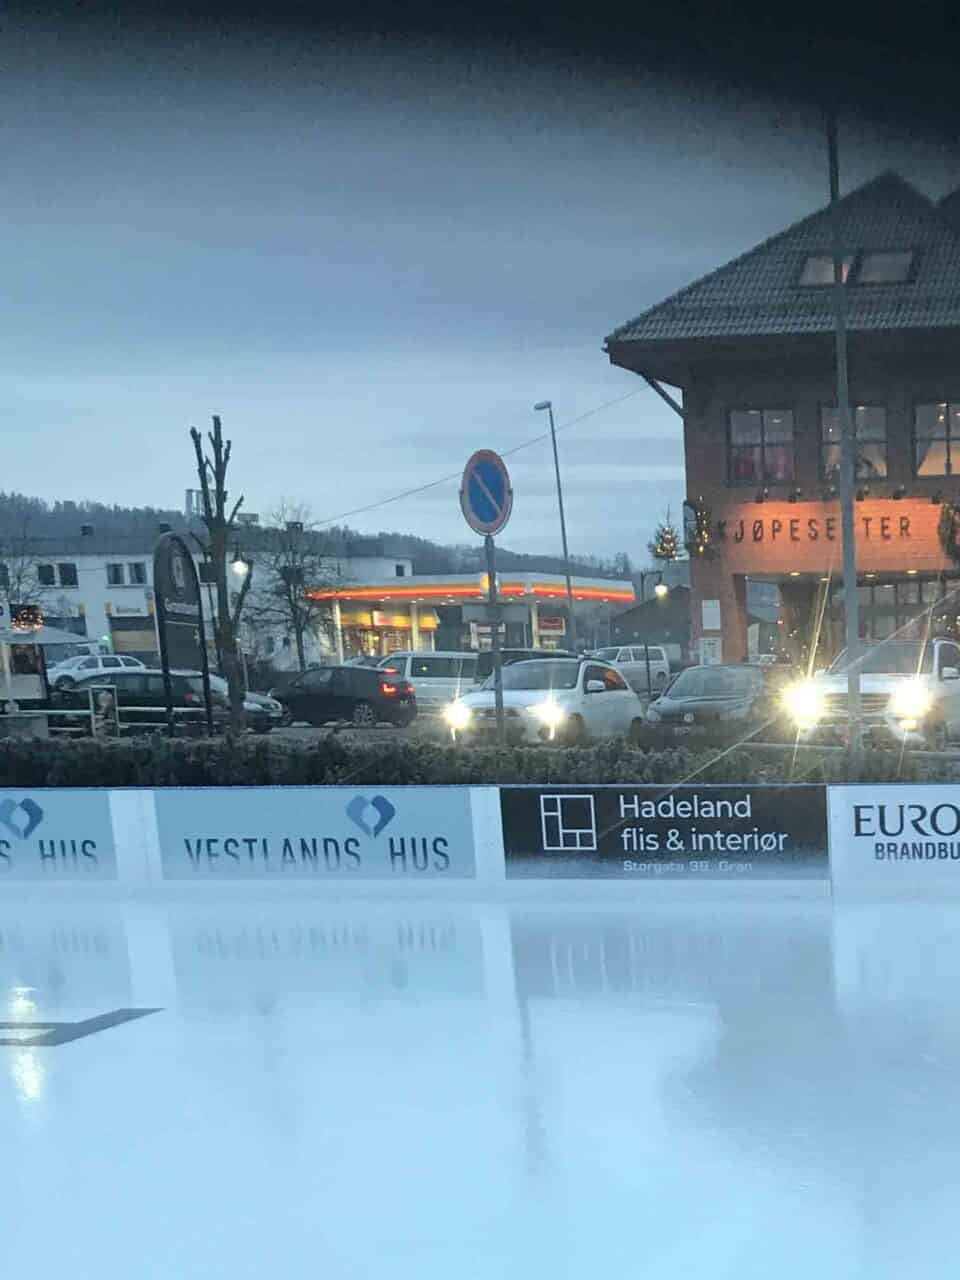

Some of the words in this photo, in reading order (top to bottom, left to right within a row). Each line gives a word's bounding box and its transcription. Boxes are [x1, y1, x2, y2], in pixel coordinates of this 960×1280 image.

[717, 516, 912, 544] KJØPESETER
[619, 793, 752, 819] Hadeland
[620, 827, 660, 852] flis
[665, 828, 685, 852] &
[690, 826, 789, 853] interiør
[38, 839, 99, 871] HUS
[184, 837, 362, 872] VESTLANDS
[388, 837, 451, 872] HUS
